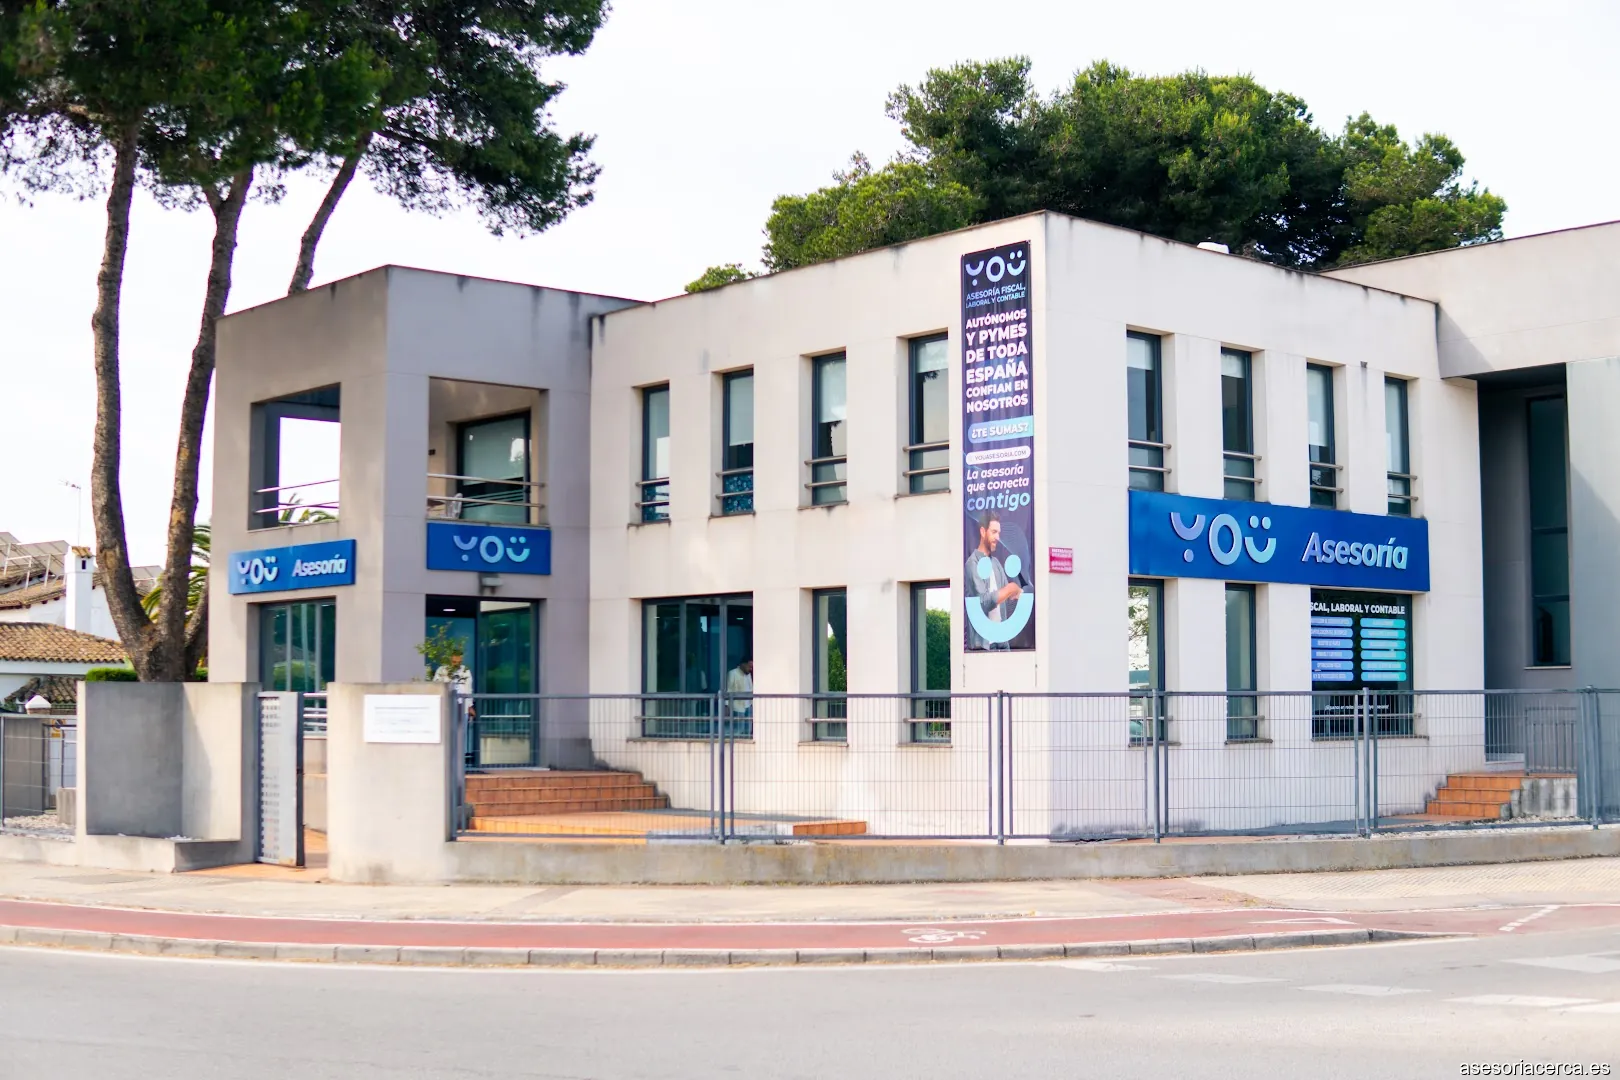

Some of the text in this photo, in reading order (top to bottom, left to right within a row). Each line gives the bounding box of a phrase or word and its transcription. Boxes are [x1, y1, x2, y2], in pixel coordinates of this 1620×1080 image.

[966, 283, 1026, 301] ASESORÍA FISCAL,
[966, 299, 990, 309] LABORAL
[997, 291, 1025, 303] CONTABLE
[966, 308, 1027, 329] AUTÓNOMOS
[966, 323, 1027, 346] Y PYMES
[966, 341, 1028, 364] DE TODA
[966, 358, 1028, 384] ESPAÑA
[966, 379, 1028, 398] CONFIAN EN
[966, 393, 1029, 413] NOSOTROS
[971, 422, 1029, 439] ¿TE SUMAS?
[966, 463, 1024, 480] La asesoría
[966, 476, 1030, 495] que conecta
[966, 489, 1031, 512] contigo
[1301, 531, 1409, 570] Asesoría
[291, 553, 347, 577] Asesoría
[1330, 603, 1363, 613] LABORAL
[1364, 605, 1370, 613] Y
[1370, 605, 1405, 614] CONTABLE
